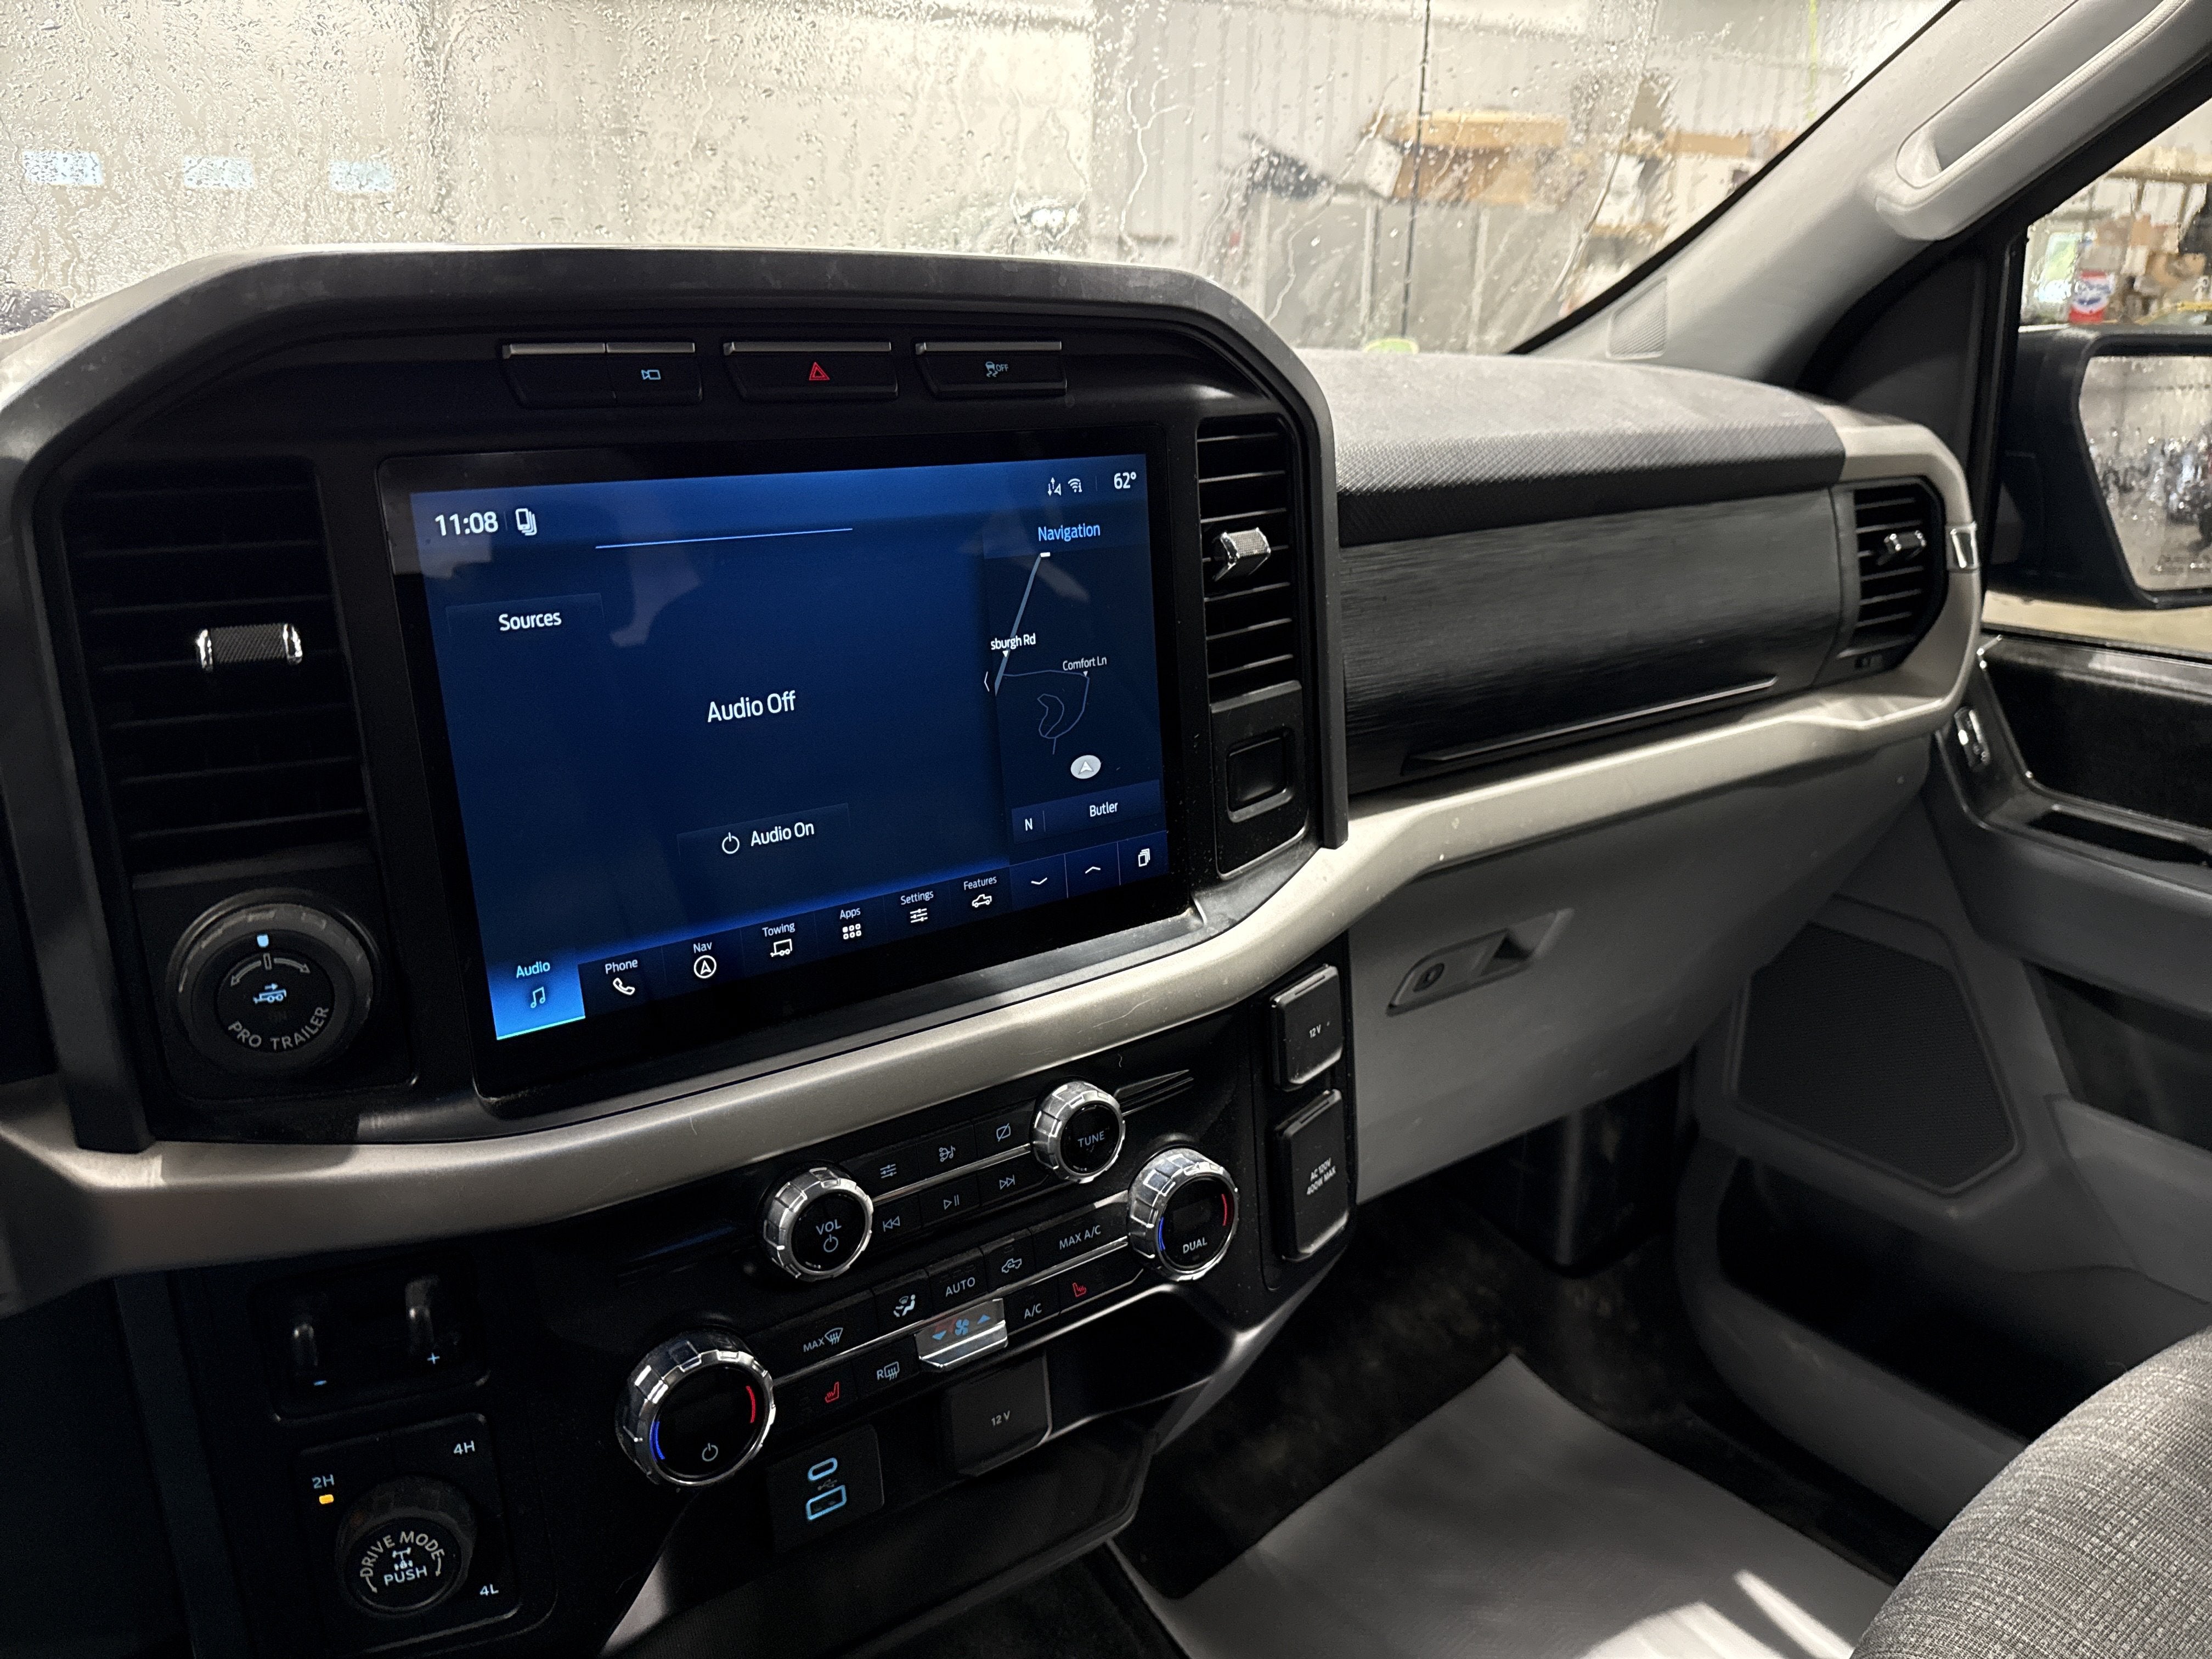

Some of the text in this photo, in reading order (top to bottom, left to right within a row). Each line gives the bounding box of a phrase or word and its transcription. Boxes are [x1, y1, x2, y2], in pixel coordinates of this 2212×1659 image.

[996, 364, 1009, 372] OFF
[1114, 471, 1137, 489] 62°
[435, 511, 499, 536] 11:08
[1038, 522, 1101, 542] Navigation
[498, 612, 562, 631] Sources
[990, 633, 1036, 650] sburgh Rd
[1062, 656, 1107, 671] Comfort Ln
[707, 690, 796, 723] Audio Off
[1089, 801, 1118, 817] Butler
[1024, 817, 1033, 831] N
[751, 822, 815, 847] Audio On
[963, 876, 997, 891] Features
[900, 890, 934, 906] Settings
[839, 907, 861, 920] Apps
[761, 921, 795, 936] Towing
[693, 942, 713, 953] Nav
[516, 961, 551, 979] Audio
[605, 959, 638, 974] Phone
[228, 1007, 329, 1051] PRO TRAILER
[1077, 1130, 1105, 1147] TUNE
[1306, 1165, 1336, 1195] 400W MAX
[815, 1218, 842, 1235] VOL
[1059, 1224, 1101, 1250] MAX A/C
[1183, 1237, 1207, 1254] DUAL
[945, 1277, 975, 1297] AUTO
[1024, 1303, 1042, 1319] A/C
[803, 1336, 825, 1353] MAX
[876, 1369, 884, 1380] R
[453, 1440, 476, 1455] 4H
[312, 1474, 335, 1489] 2H
[359, 1531, 445, 1578] DRIVE MODE
[383, 1565, 428, 1585] PUSH
[479, 1584, 499, 1596] 4L
